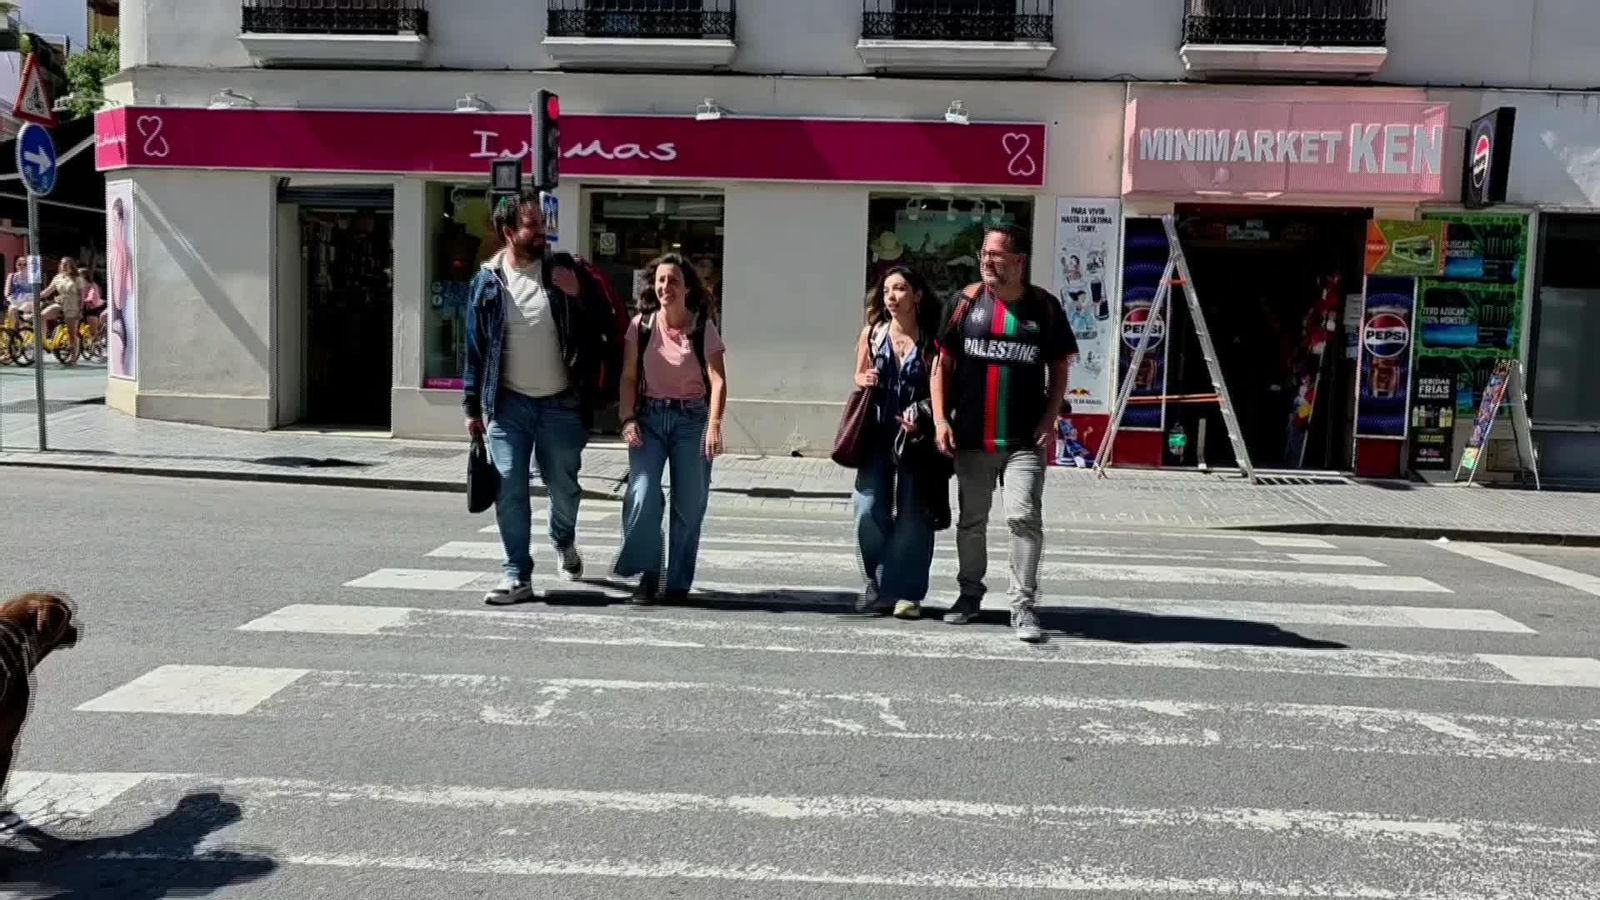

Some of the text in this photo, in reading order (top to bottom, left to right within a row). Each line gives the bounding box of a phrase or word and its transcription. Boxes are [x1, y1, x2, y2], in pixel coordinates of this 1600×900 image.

[1140, 128, 1342, 163] MINIMARKET
[1349, 122, 1442, 174] KEN
[1070, 207, 1087, 215] PARA
[1061, 215, 1080, 224] HASTA
[1081, 216, 1089, 224] LA
[1123, 324, 1162, 335] PESI
[1366, 331, 1406, 341] PEPSI
[964, 337, 1040, 363] PALESTINE
